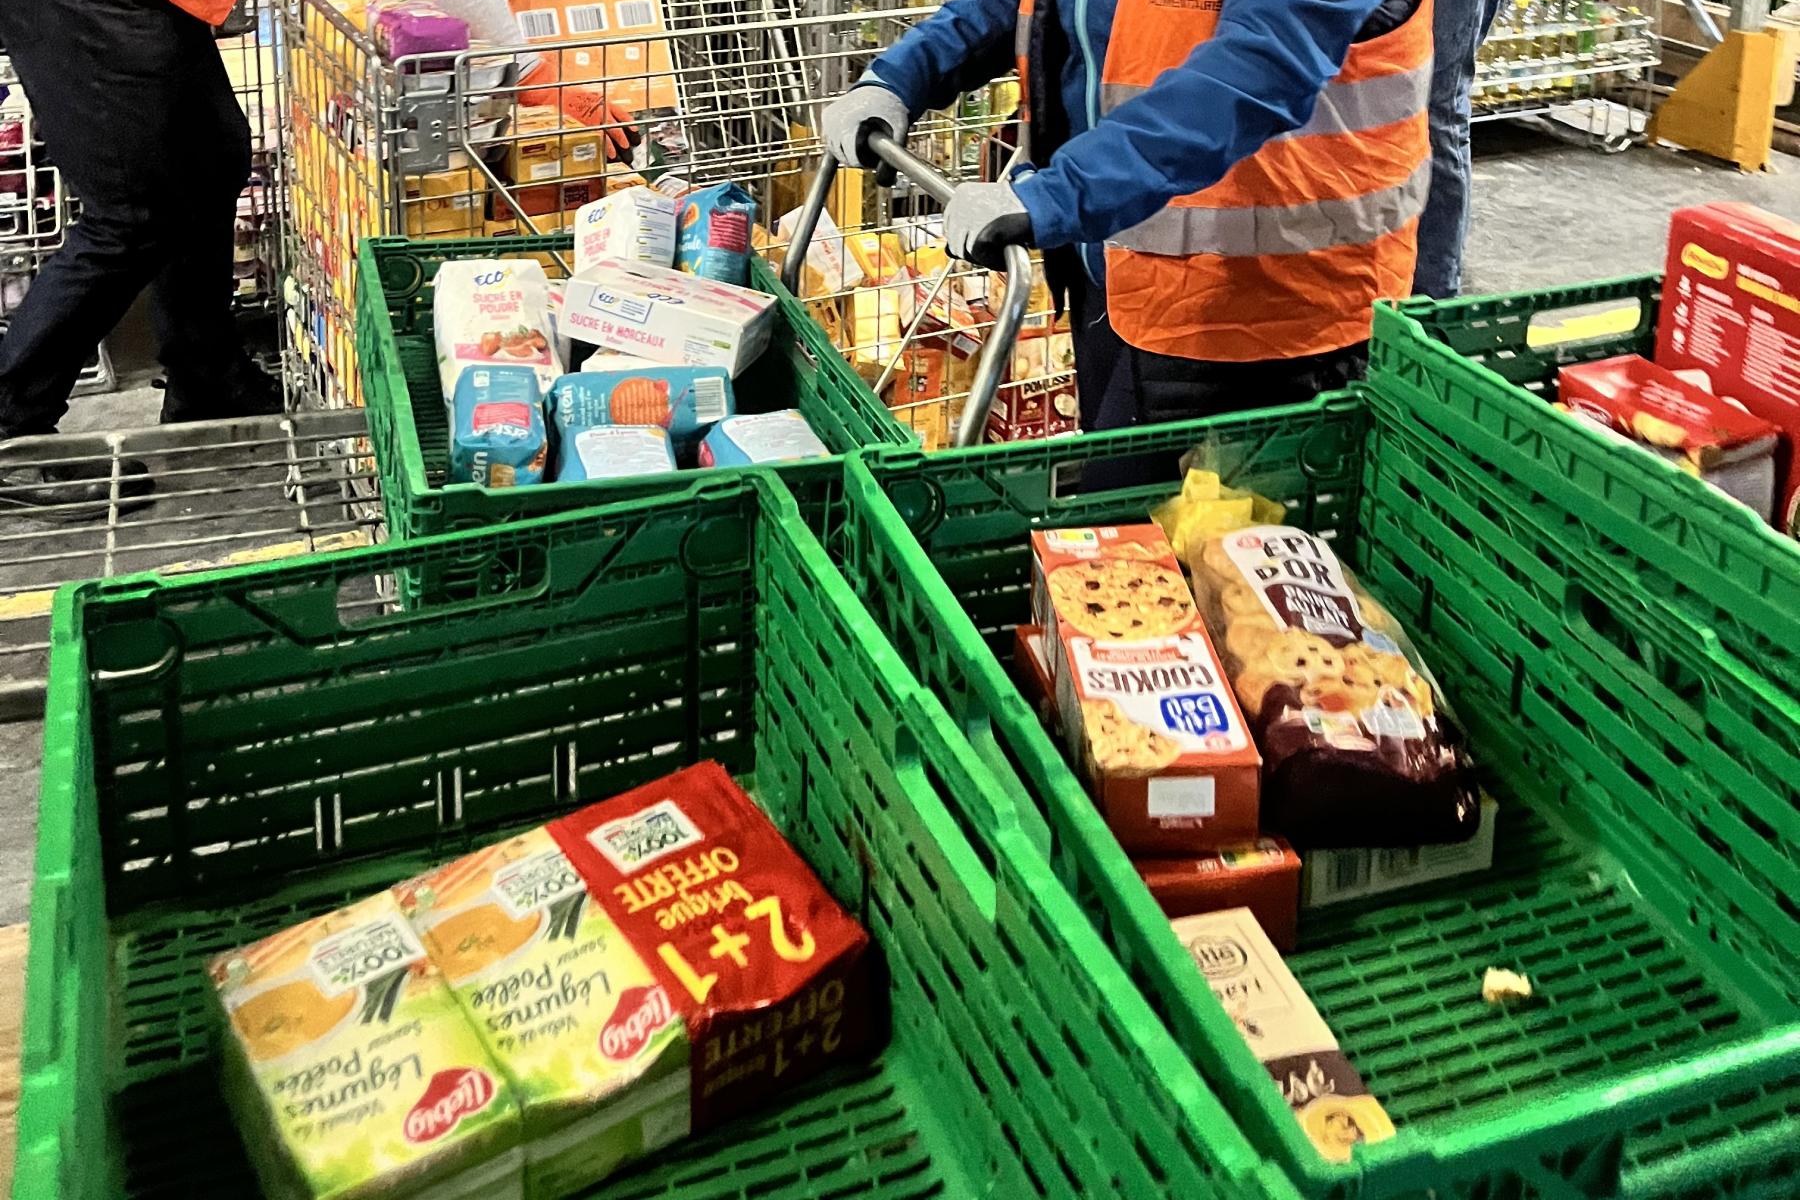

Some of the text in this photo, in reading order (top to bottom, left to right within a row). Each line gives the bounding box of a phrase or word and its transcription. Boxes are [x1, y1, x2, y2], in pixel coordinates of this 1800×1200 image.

[473, 291, 507, 303] SUCRE
[479, 302, 520, 315] POUDRE
[569, 312, 599, 330] SUCRE
[602, 321, 613, 334] EN
[615, 324, 666, 349] MORCEAUX
[1086, 663, 1215, 696] COOKIES
[613, 846, 740, 914] OFFERTE
[486, 969, 611, 1031] Légumes
[602, 987, 672, 1056] Liebig
[283, 1052, 422, 1118] Légumes
[406, 1072, 485, 1137] Liebig
